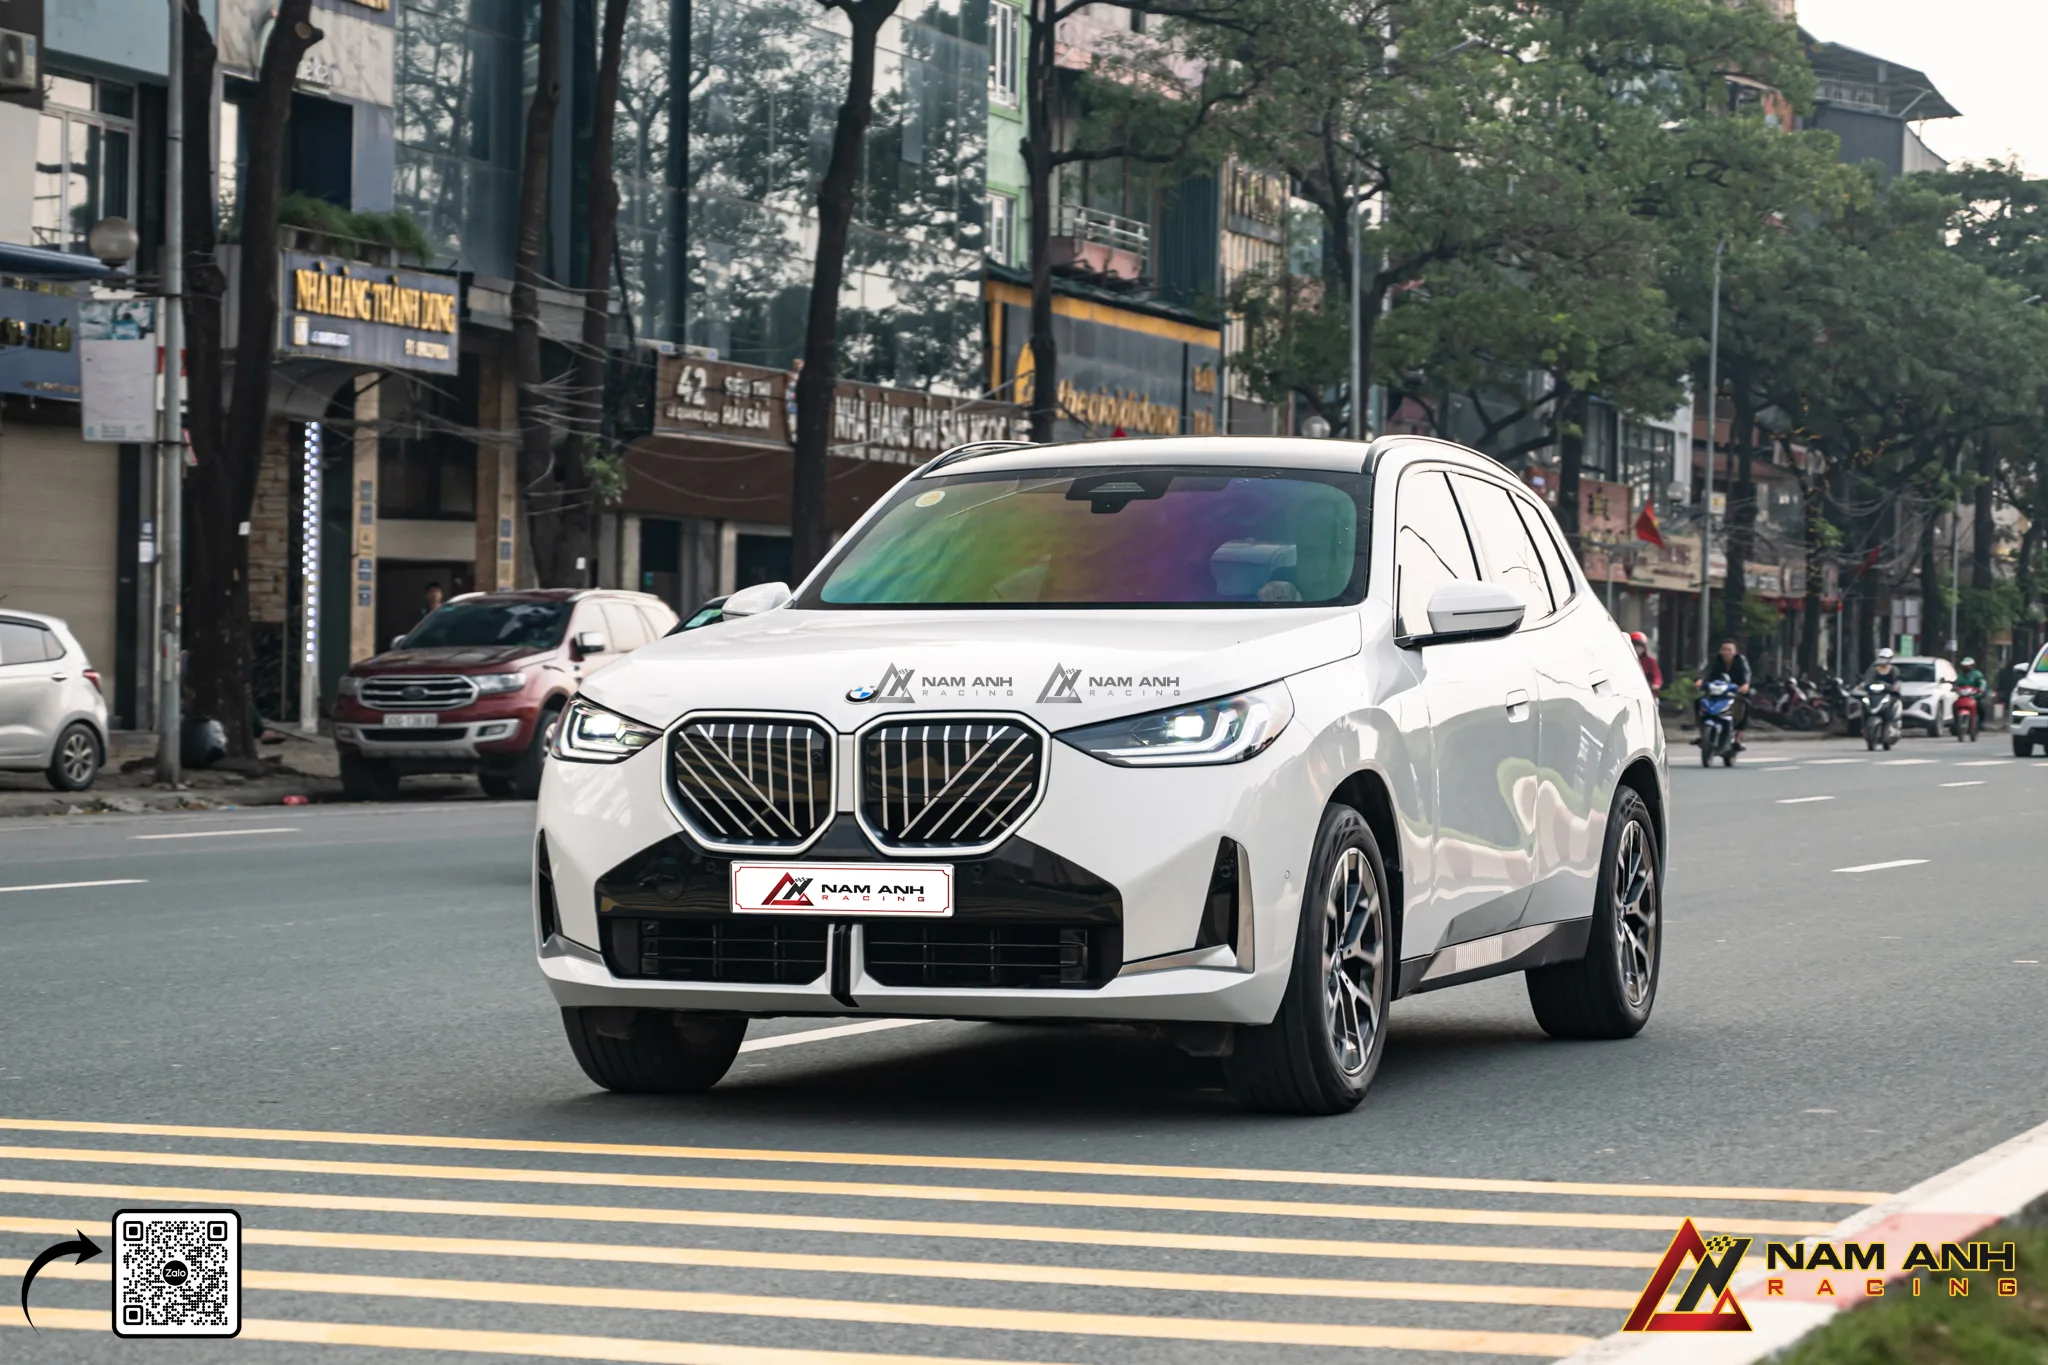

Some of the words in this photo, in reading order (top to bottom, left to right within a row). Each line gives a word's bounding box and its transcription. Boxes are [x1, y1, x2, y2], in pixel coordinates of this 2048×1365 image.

[296, 261, 328, 315] NHÀ
[330, 265, 371, 321] HÀNG
[677, 365, 707, 405] 42
[834, 388, 867, 441] NHÀ
[869, 393, 912, 448] HÀNG
